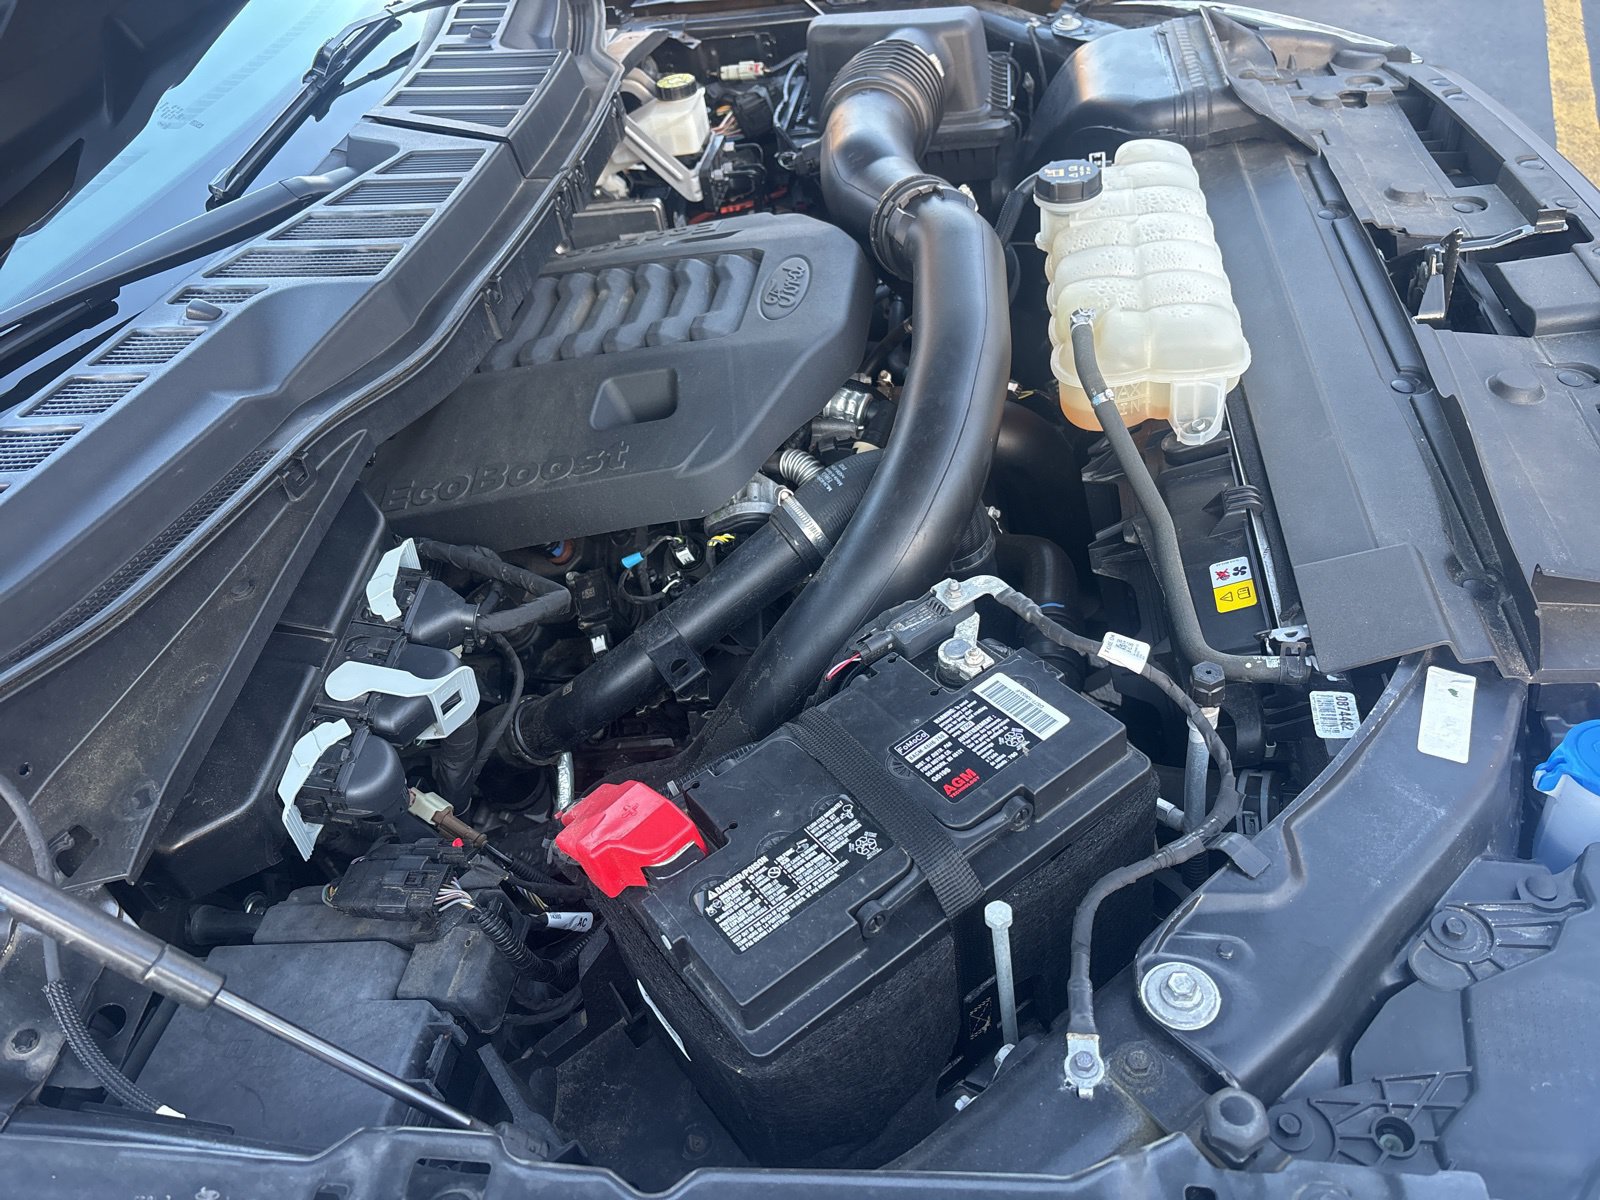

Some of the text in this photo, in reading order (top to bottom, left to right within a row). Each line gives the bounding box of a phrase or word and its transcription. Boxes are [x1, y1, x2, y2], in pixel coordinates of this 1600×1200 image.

[764, 266, 806, 308] Ford
[896, 731, 927, 753] FoMoCo
[940, 767, 977, 795] AGM
[949, 775, 980, 798] TECHNOLOGY
[715, 855, 769, 894] DANGER/POISON
[577, 917, 588, 928] AC
